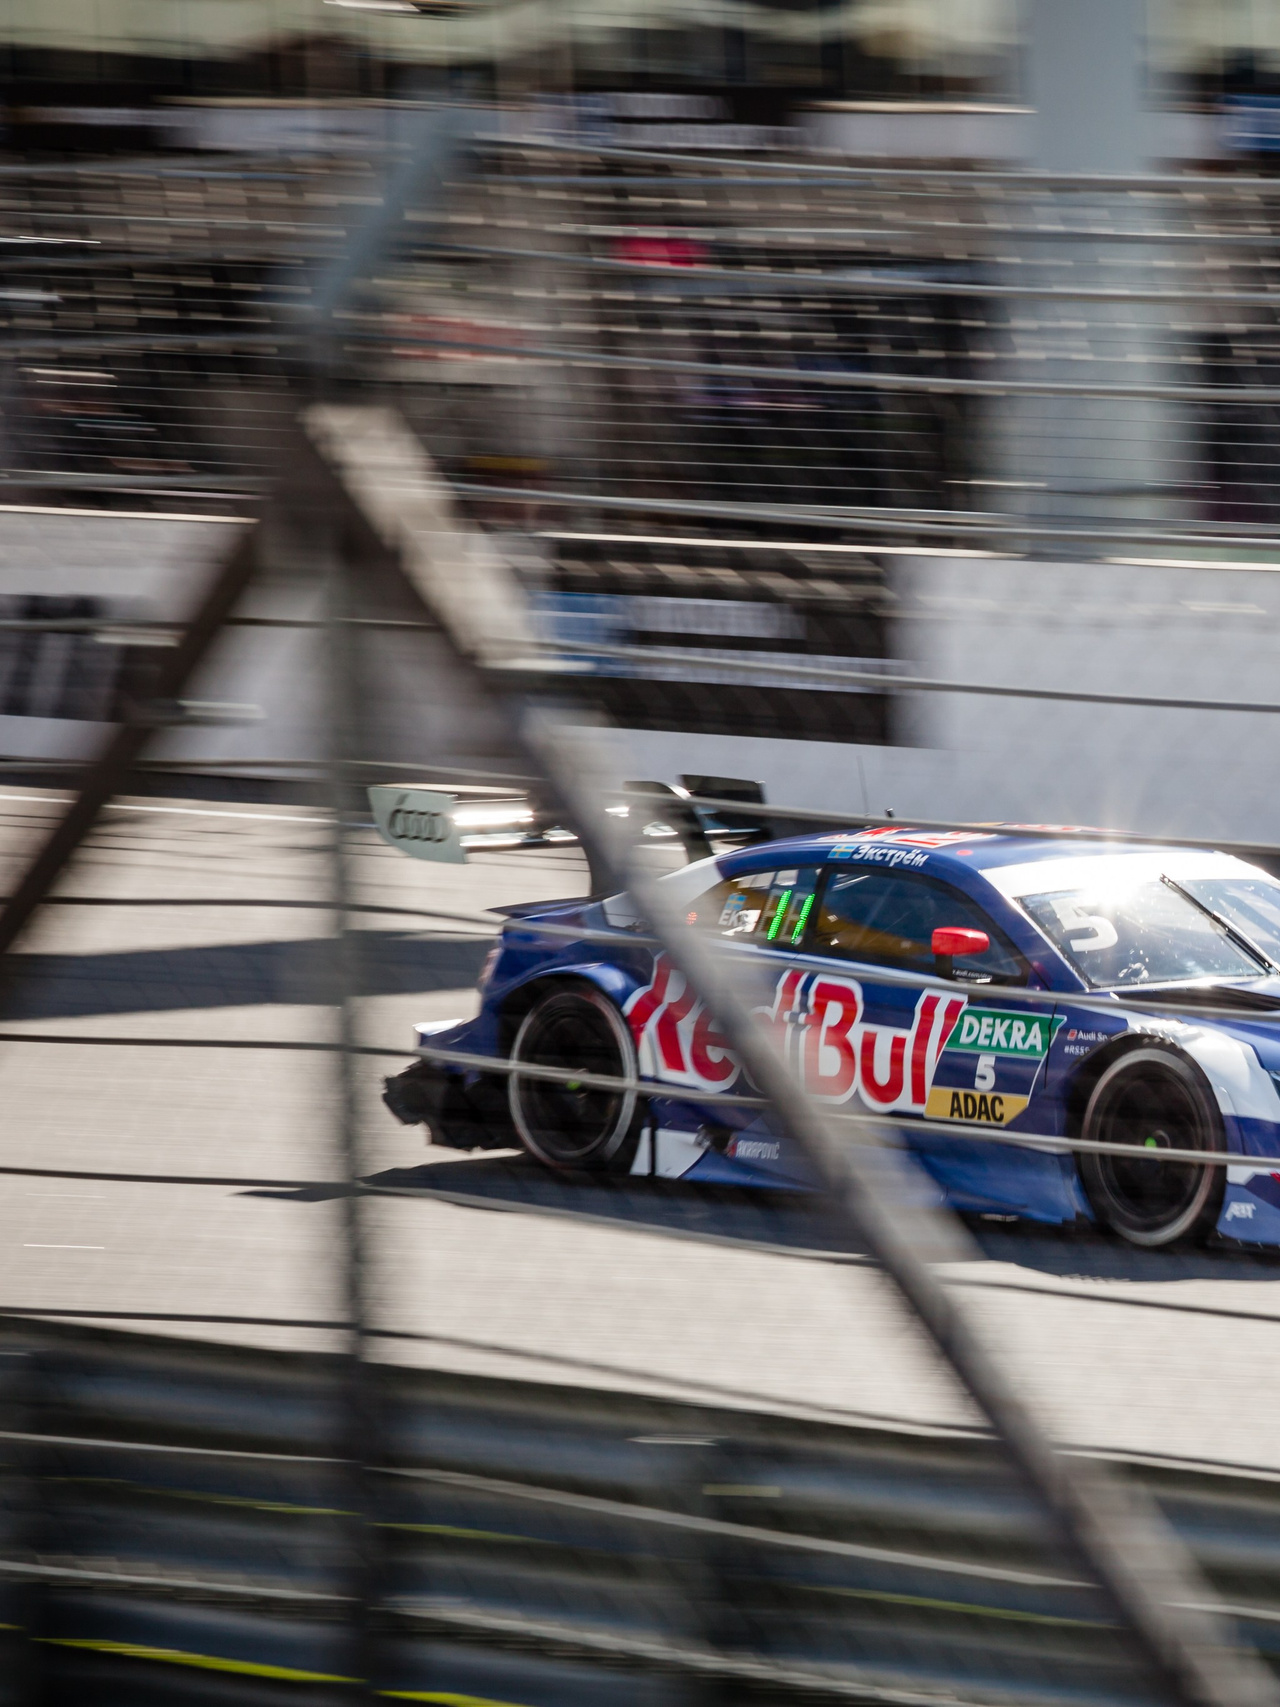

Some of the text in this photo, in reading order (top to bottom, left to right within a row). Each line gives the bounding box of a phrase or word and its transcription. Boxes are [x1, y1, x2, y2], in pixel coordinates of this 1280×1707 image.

[852, 844, 930, 868] Экстрём
[1050, 899, 1118, 953] 5
[802, 973, 968, 1113] Bull
[959, 1014, 1043, 1052] DEKRA
[1077, 1030, 1096, 1041] Audi
[974, 1053, 996, 1092] 5
[950, 1091, 1005, 1122] ADAC
